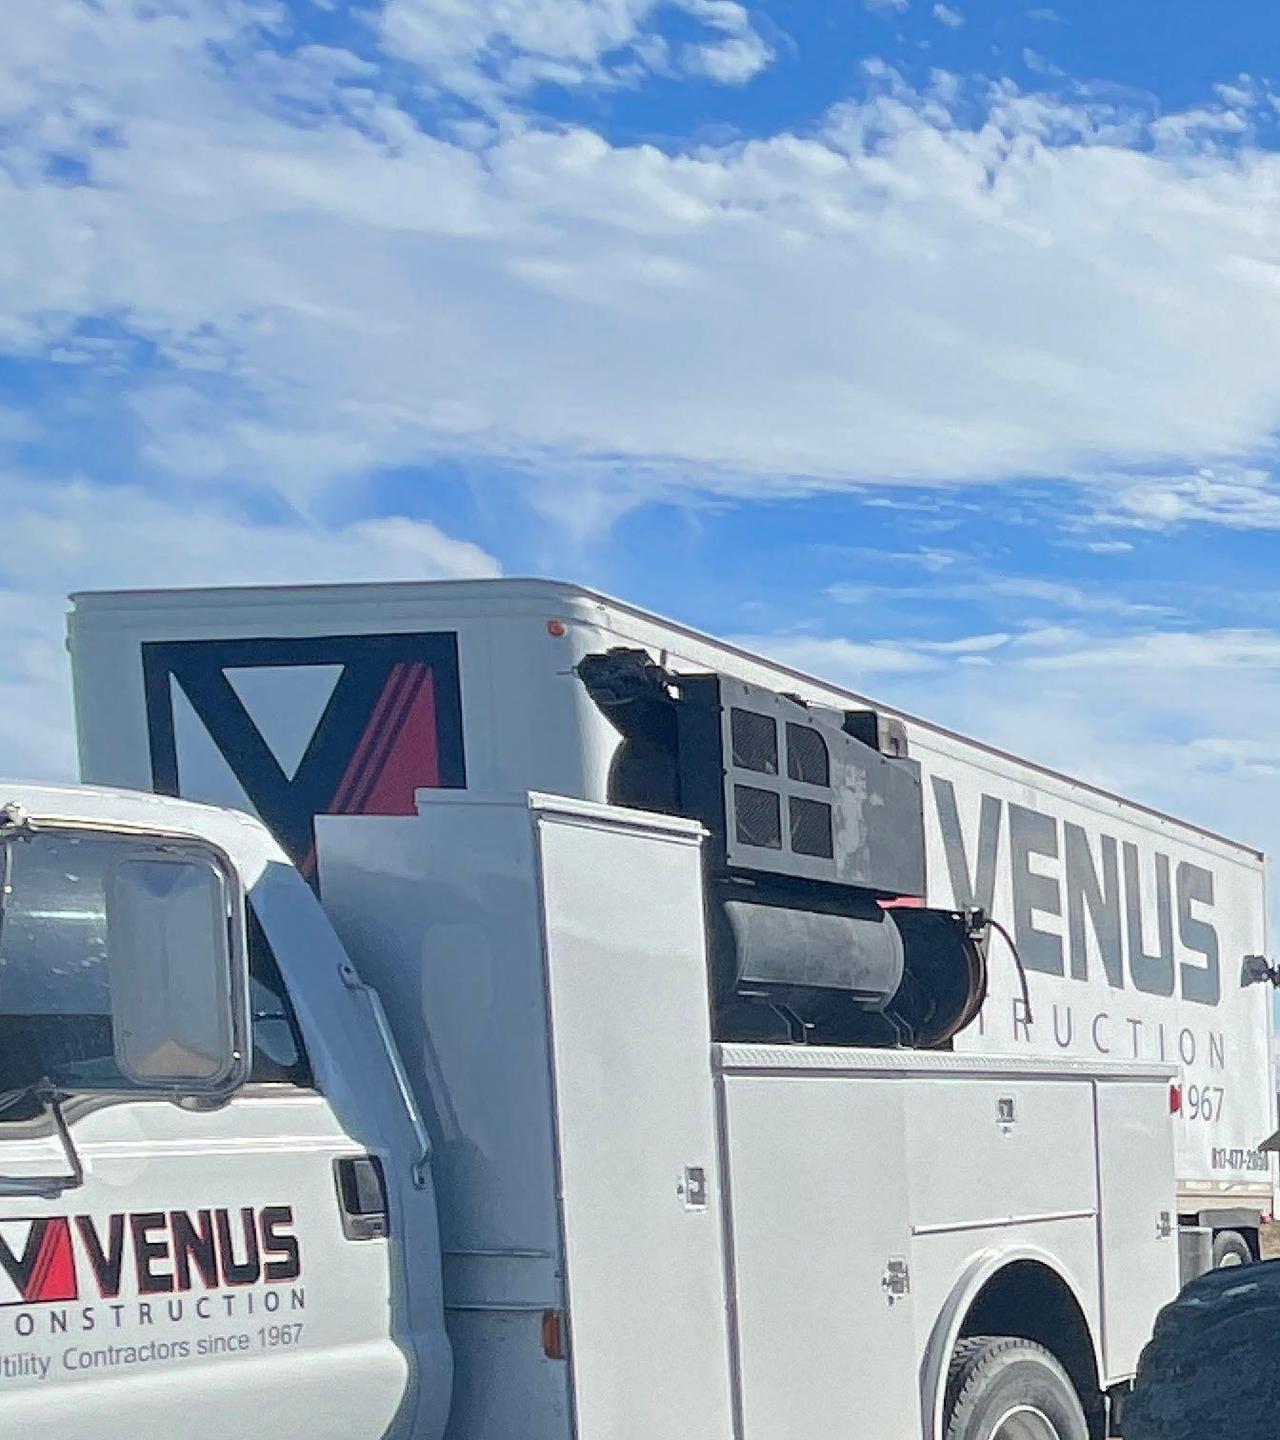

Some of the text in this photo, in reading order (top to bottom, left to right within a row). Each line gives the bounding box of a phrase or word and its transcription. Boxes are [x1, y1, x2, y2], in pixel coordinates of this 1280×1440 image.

[929, 775, 1221, 1007] VENUS
[75, 1205, 302, 1299] VENUS
[0, 1323, 304, 1380] tility Contractors since 1967
